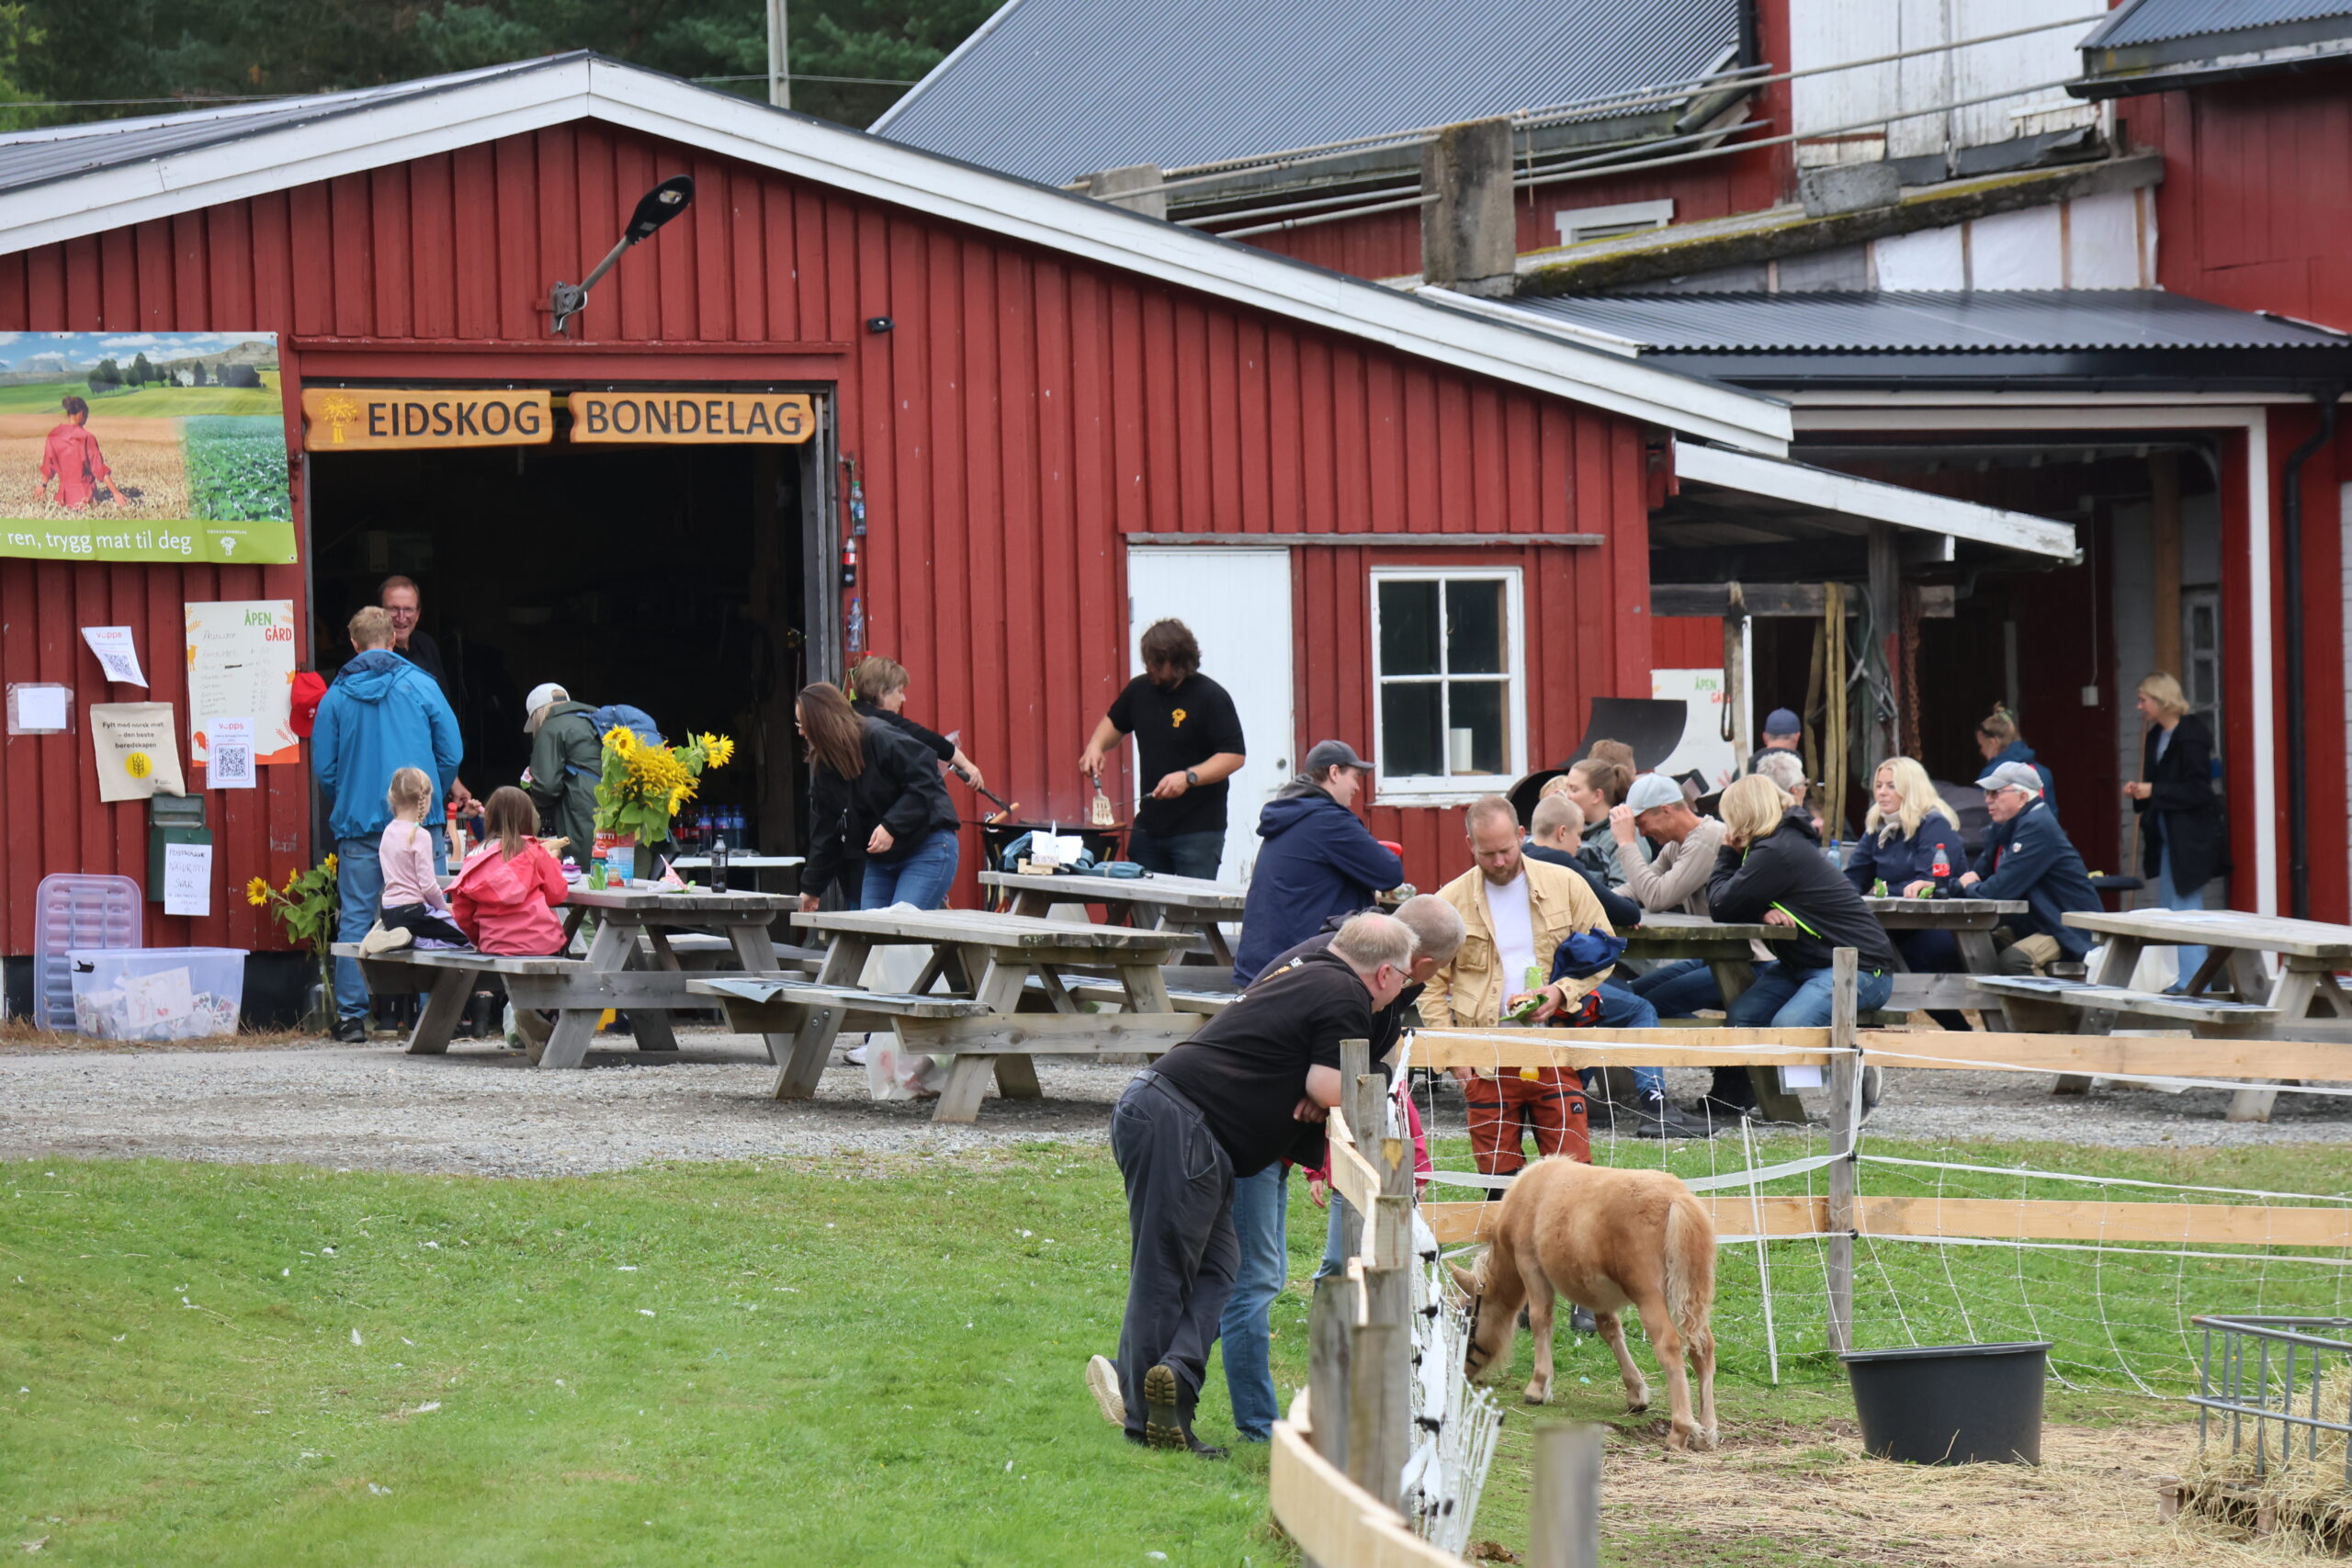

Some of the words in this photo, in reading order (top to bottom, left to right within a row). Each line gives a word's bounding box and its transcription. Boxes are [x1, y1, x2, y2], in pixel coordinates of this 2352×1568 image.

[368, 400, 540, 436] EIDSKOG
[586, 400, 802, 436] BONDELAG
[7, 532, 41, 549] ren,
[45, 531, 93, 554] trygg
[96, 533, 130, 549] mat
[135, 529, 153, 549] til
[158, 529, 192, 555] deg
[244, 609, 272, 626] ÅPEN
[265, 625, 292, 642] GÅRD
[1695, 677, 1716, 690] ÅPEN
[115, 741, 157, 750] beredskapen
